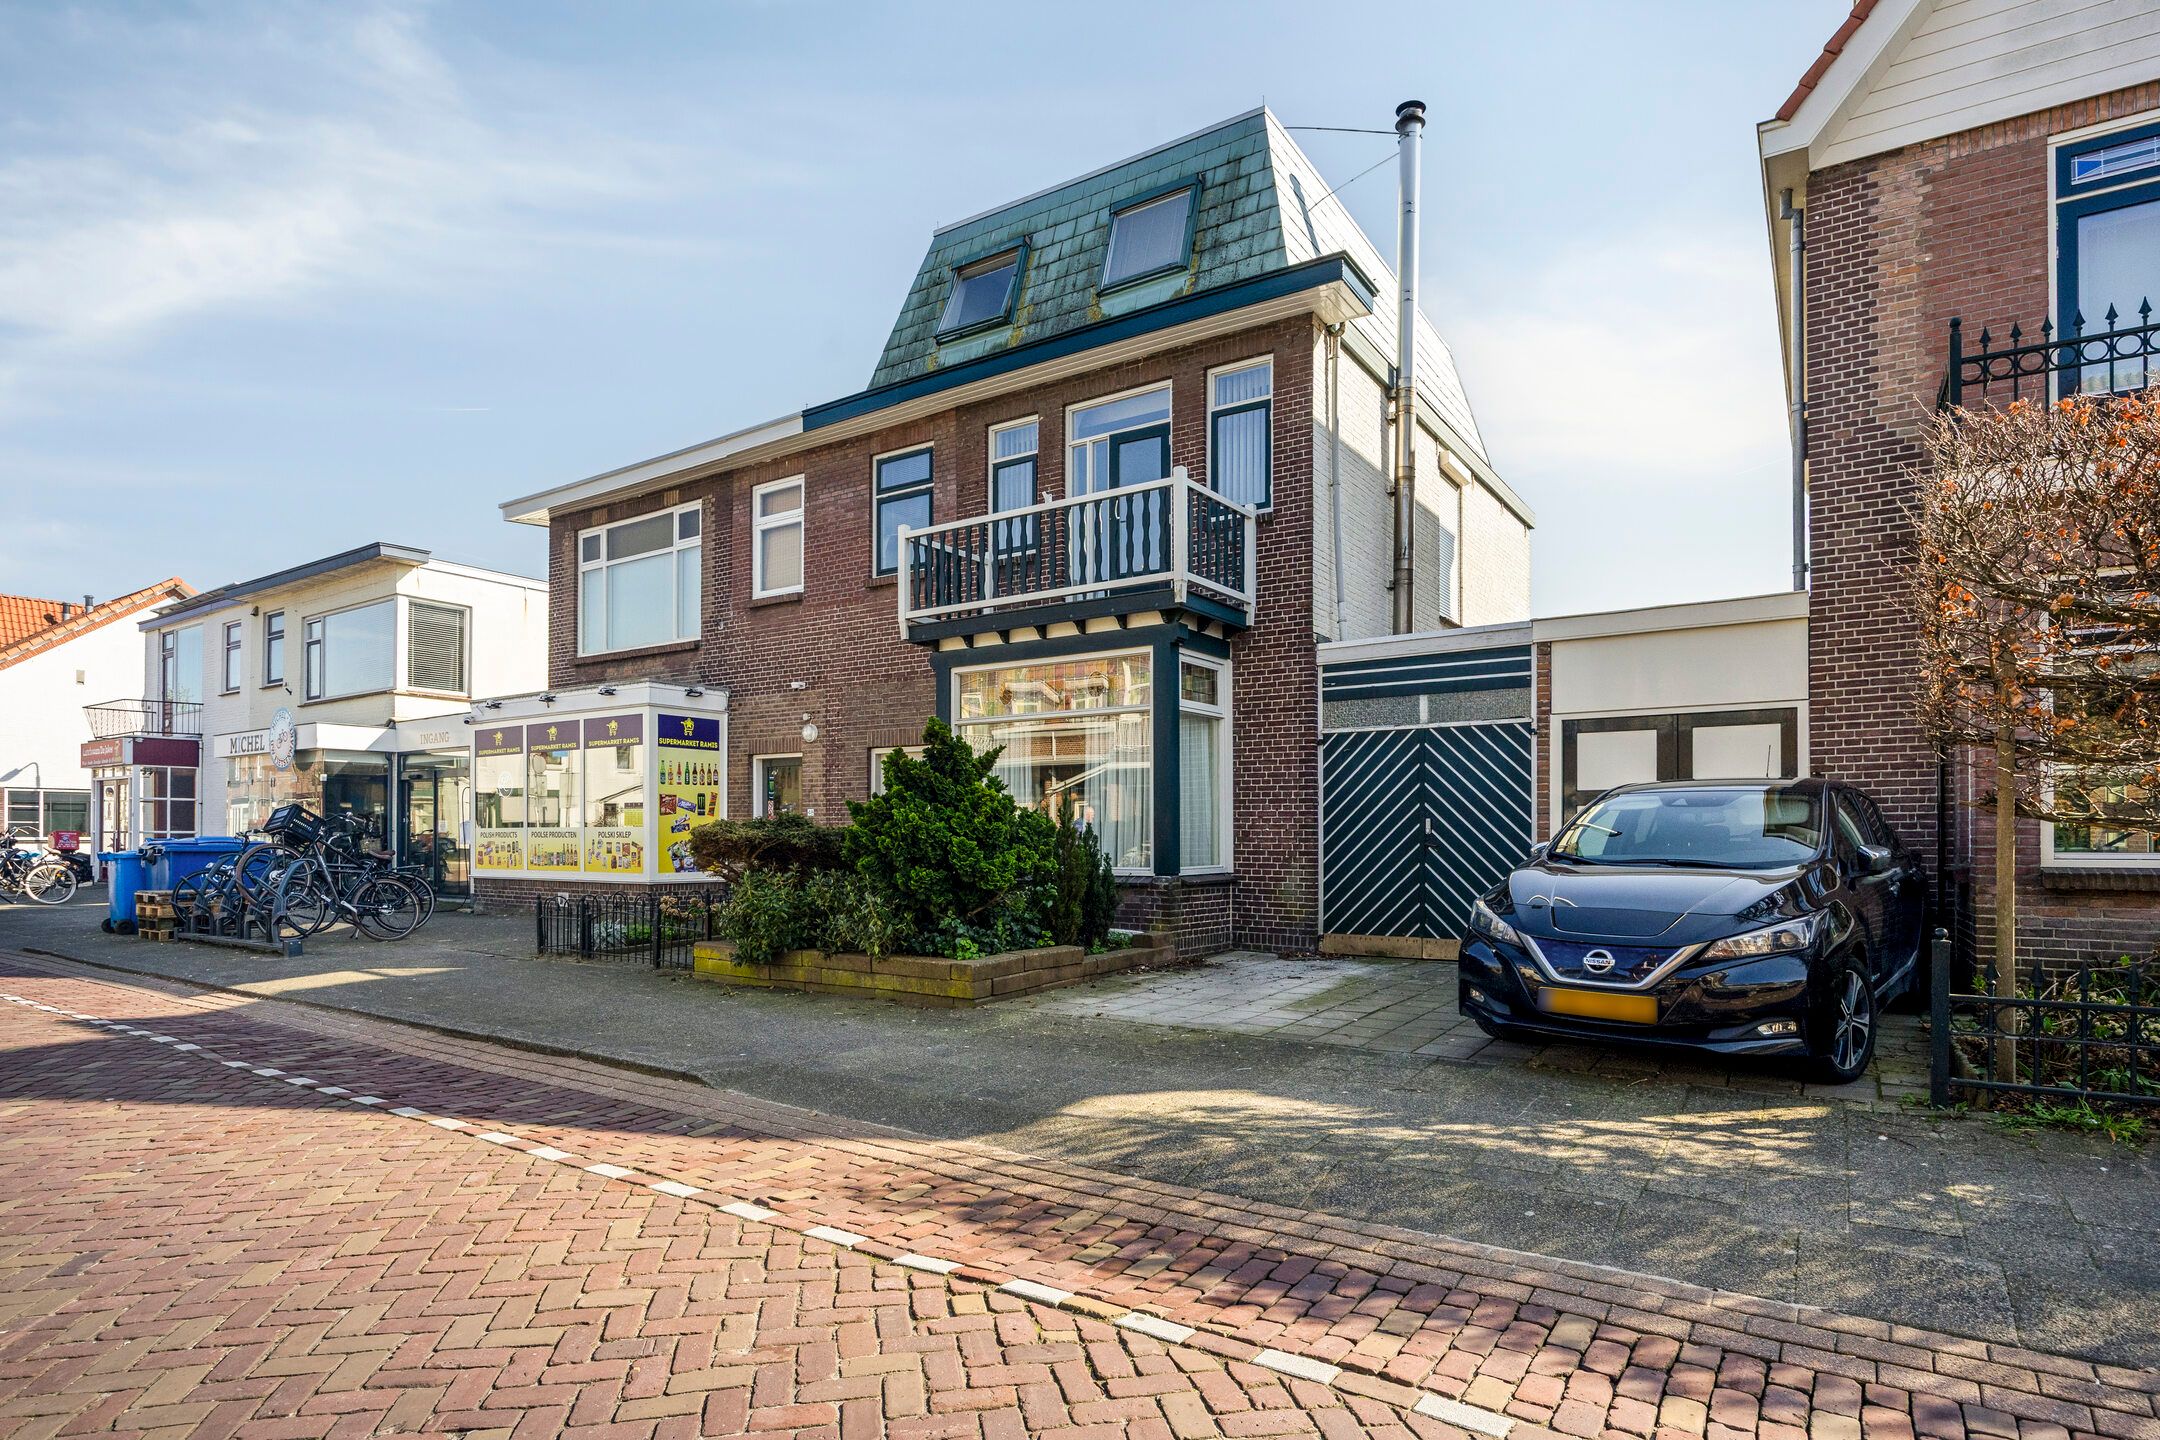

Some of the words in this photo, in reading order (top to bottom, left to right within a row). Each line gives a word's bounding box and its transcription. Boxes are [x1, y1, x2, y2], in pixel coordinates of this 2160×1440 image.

[420, 731, 449, 744] INGANG
[230, 734, 265, 754] MICHEL
[531, 743, 561, 751] SUPERMARKET
[589, 738, 622, 747] SUPERMARKET
[659, 738, 699, 747] SUPERMARKET
